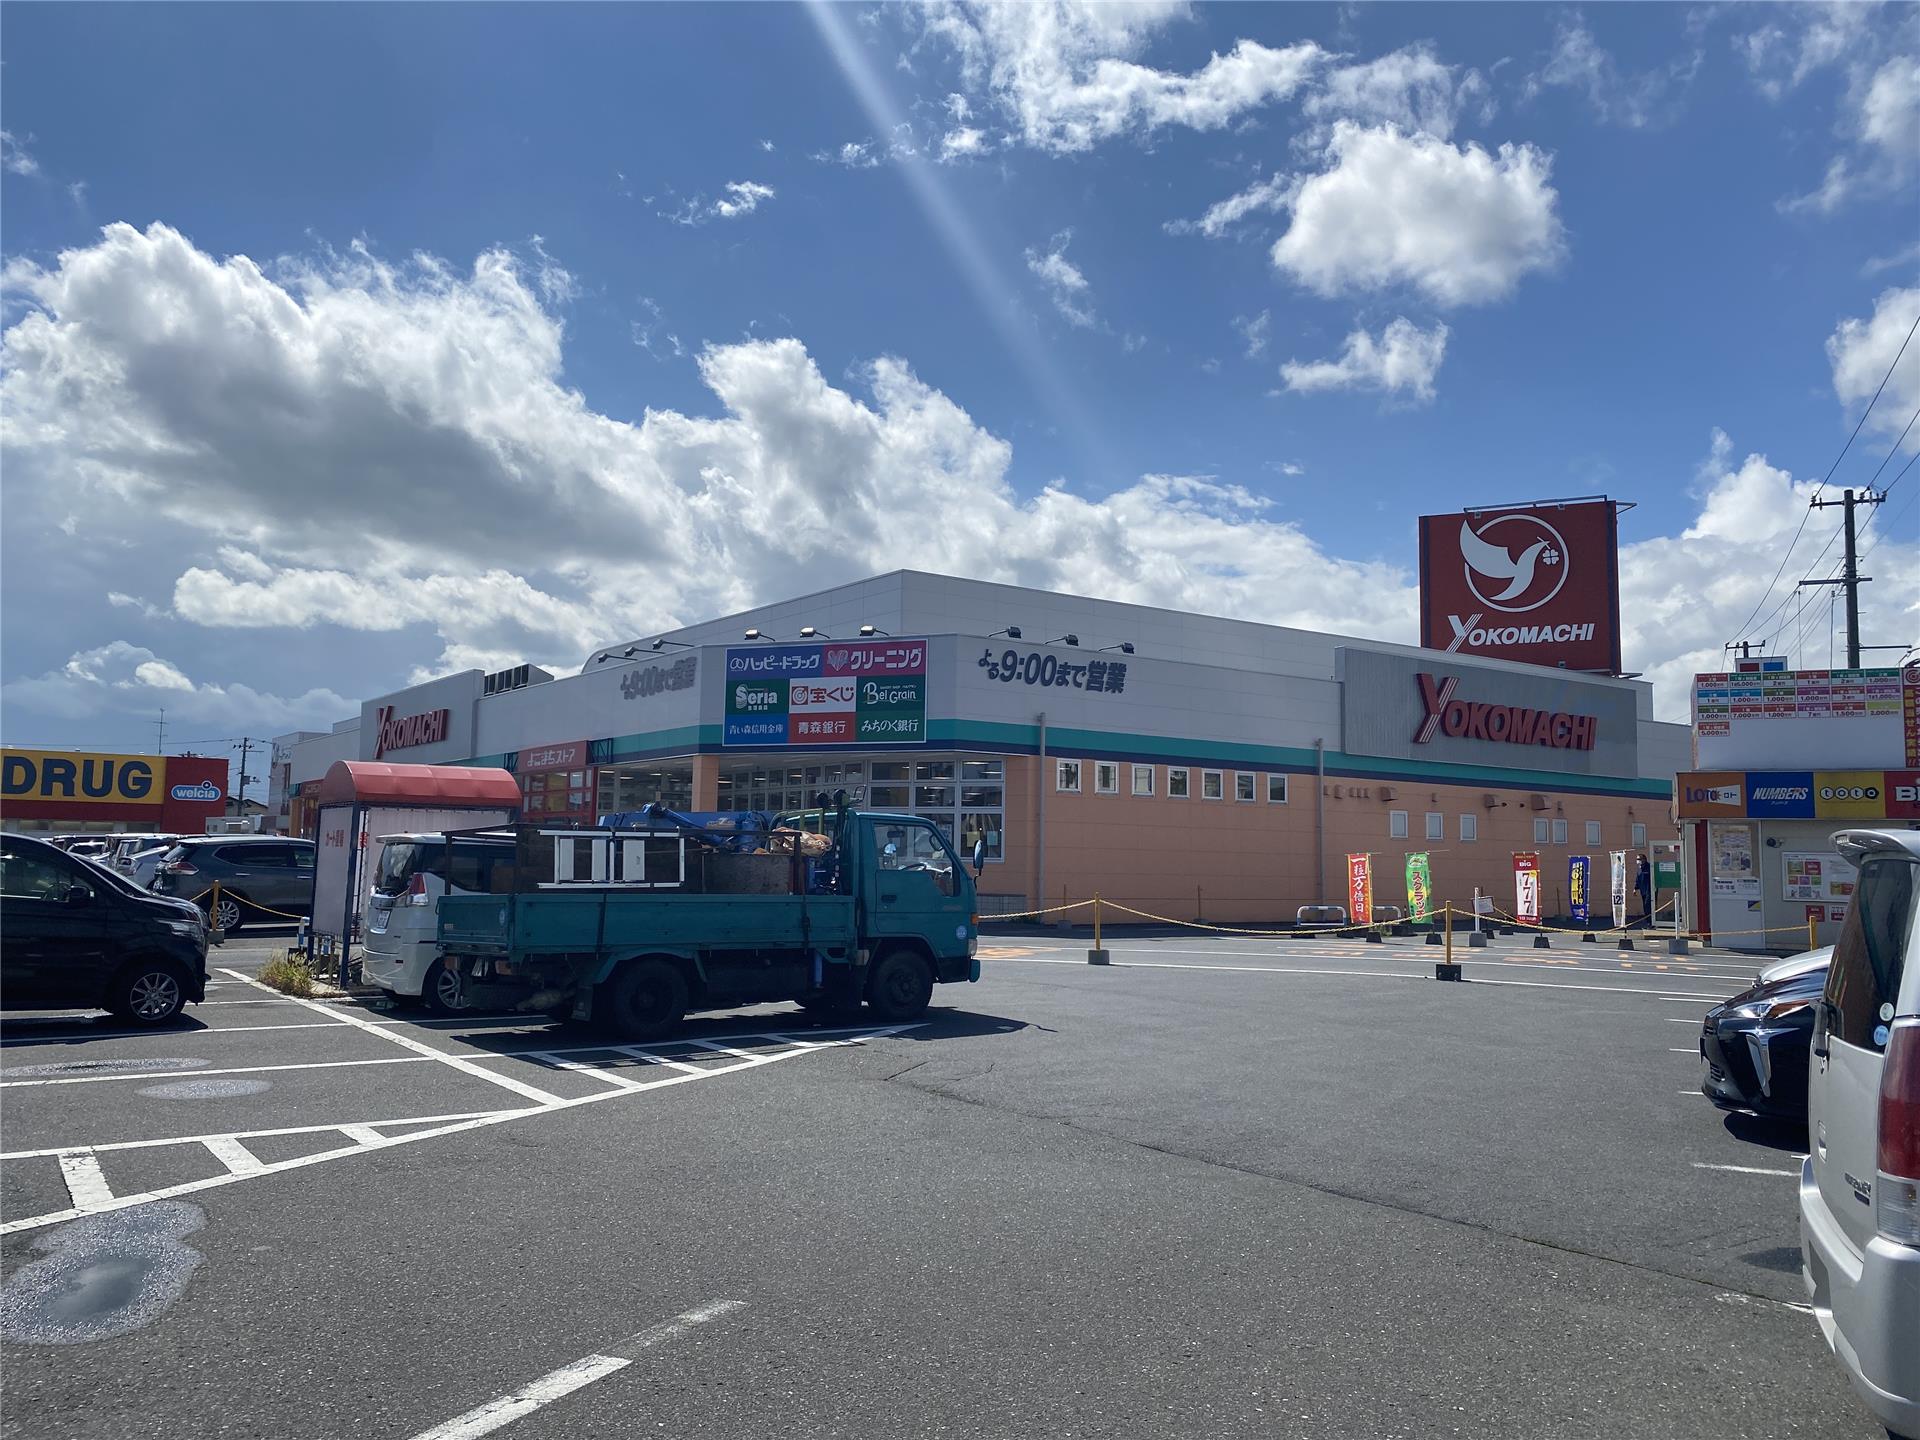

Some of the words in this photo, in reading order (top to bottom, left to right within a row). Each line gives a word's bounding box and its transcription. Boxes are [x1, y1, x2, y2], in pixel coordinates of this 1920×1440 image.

[1445, 613, 1595, 655] YOKOMACHI
[850, 648, 922, 670] クリーニング
[978, 649, 1127, 694] よる9:00まで営業
[736, 684, 778, 709] Seria
[810, 686, 854, 704] 宝くじ
[863, 682, 888, 704] Bel
[889, 690, 917, 704] Grain
[1411, 673, 1597, 751] YOKOMACHI
[374, 705, 449, 760] YOKOMACHI
[798, 721, 846, 734] 青森銀行
[861, 719, 919, 733] みちのく銀行
[1, 755, 153, 798] DRUG
[176, 786, 216, 798] welcia
[1753, 787, 1808, 800] NUMBERS
[1822, 787, 1878, 799] toto
